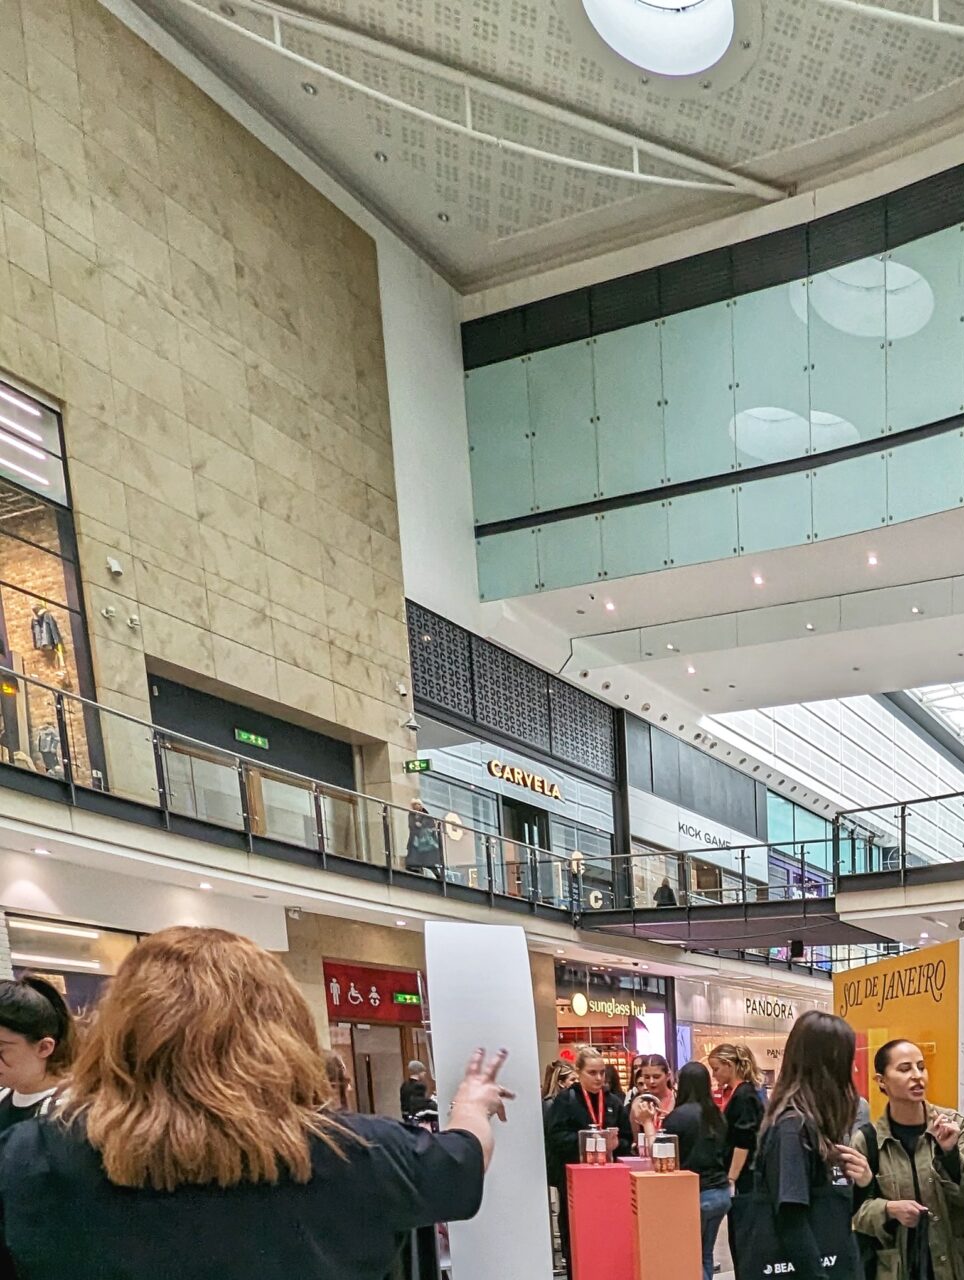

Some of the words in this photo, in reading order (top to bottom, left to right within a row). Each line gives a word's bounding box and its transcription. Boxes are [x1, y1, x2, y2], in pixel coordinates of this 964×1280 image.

[487, 759, 562, 800] CARVELA
[678, 821, 702, 844] KICK
[839, 979, 863, 1018] SOL
[865, 976, 879, 999] DE
[877, 959, 946, 1013] JANEIRO
[589, 997, 630, 1018] sunglass
[631, 1000, 647, 1017] hut
[745, 998, 794, 1019] PANDORA
[820, 1255, 837, 1267] AY
